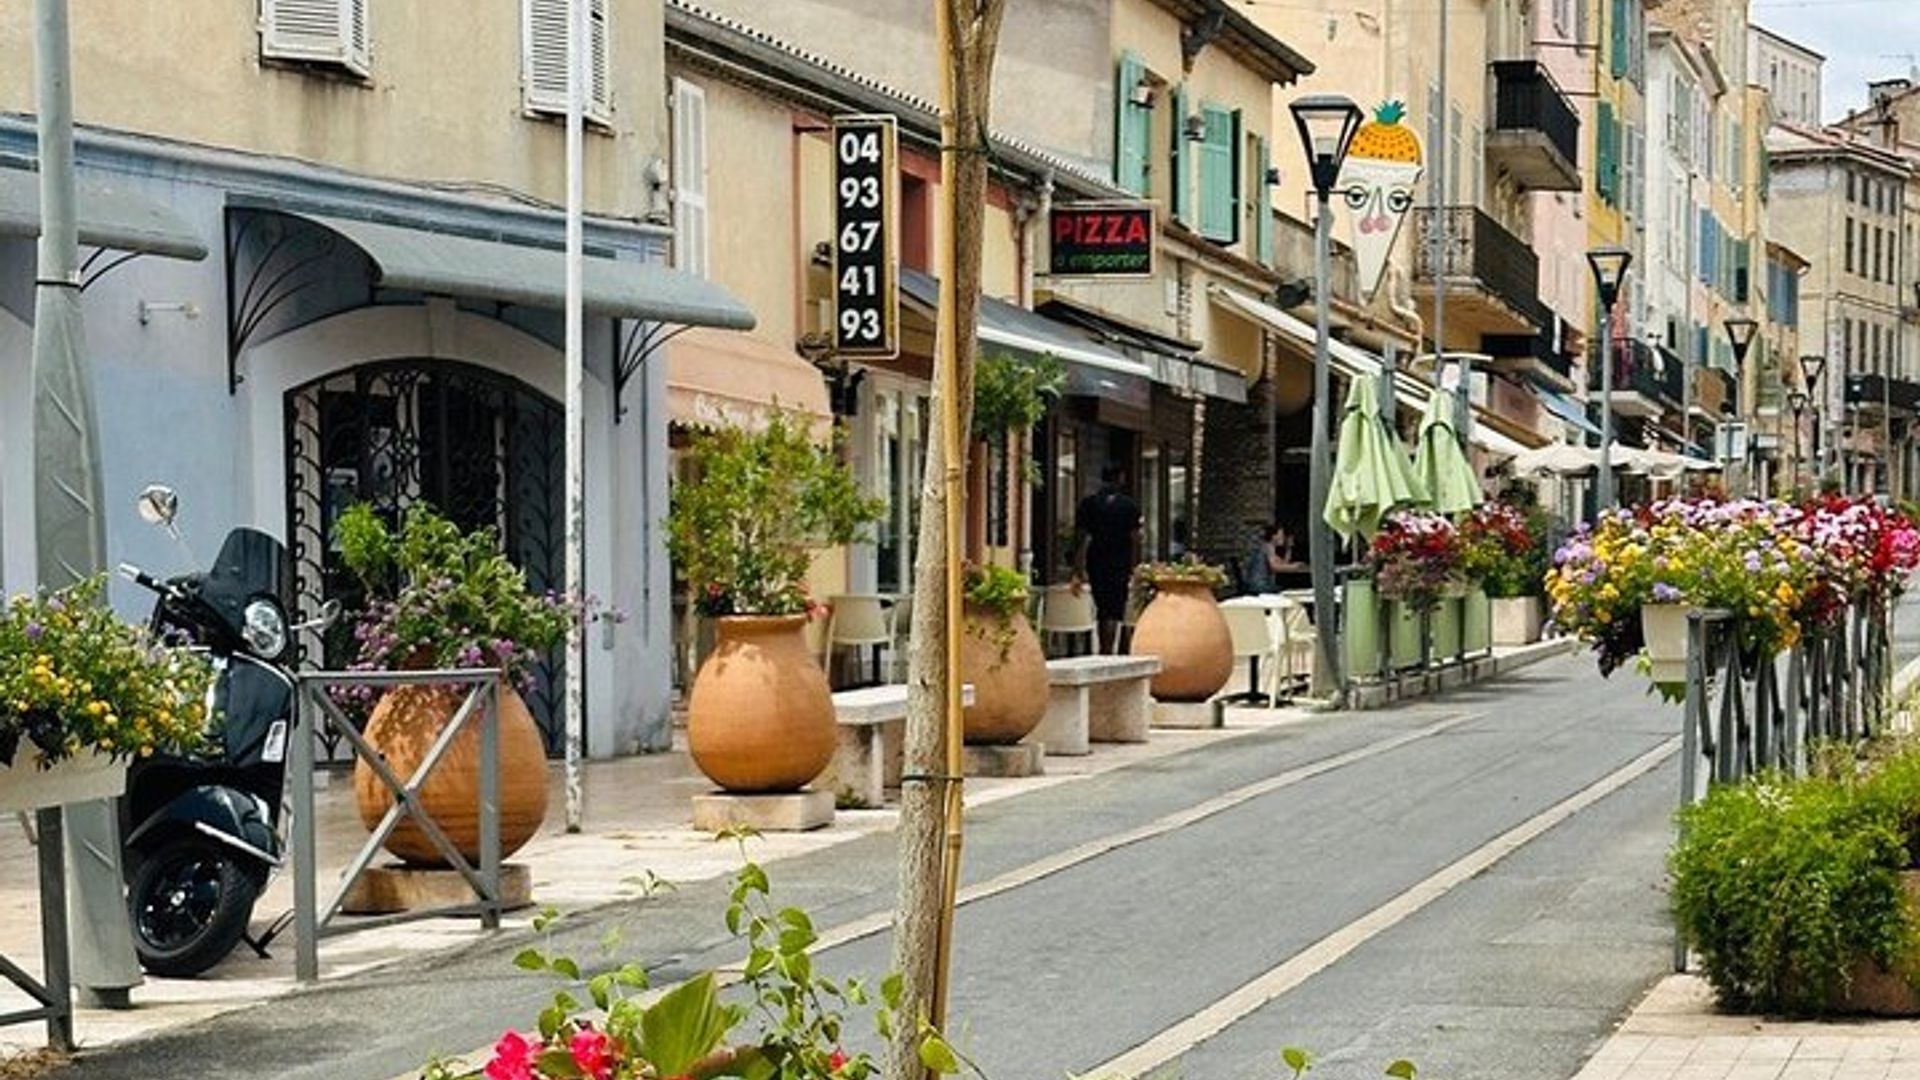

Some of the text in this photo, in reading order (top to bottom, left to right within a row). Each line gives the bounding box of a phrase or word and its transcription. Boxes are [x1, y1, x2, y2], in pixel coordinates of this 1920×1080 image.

[840, 132, 880, 164] 04
[840, 177, 880, 208] 93
[840, 222, 880, 253] 67
[1055, 215, 1147, 243] PIZZA
[840, 265, 877, 296] 41
[841, 308, 880, 340] 93
